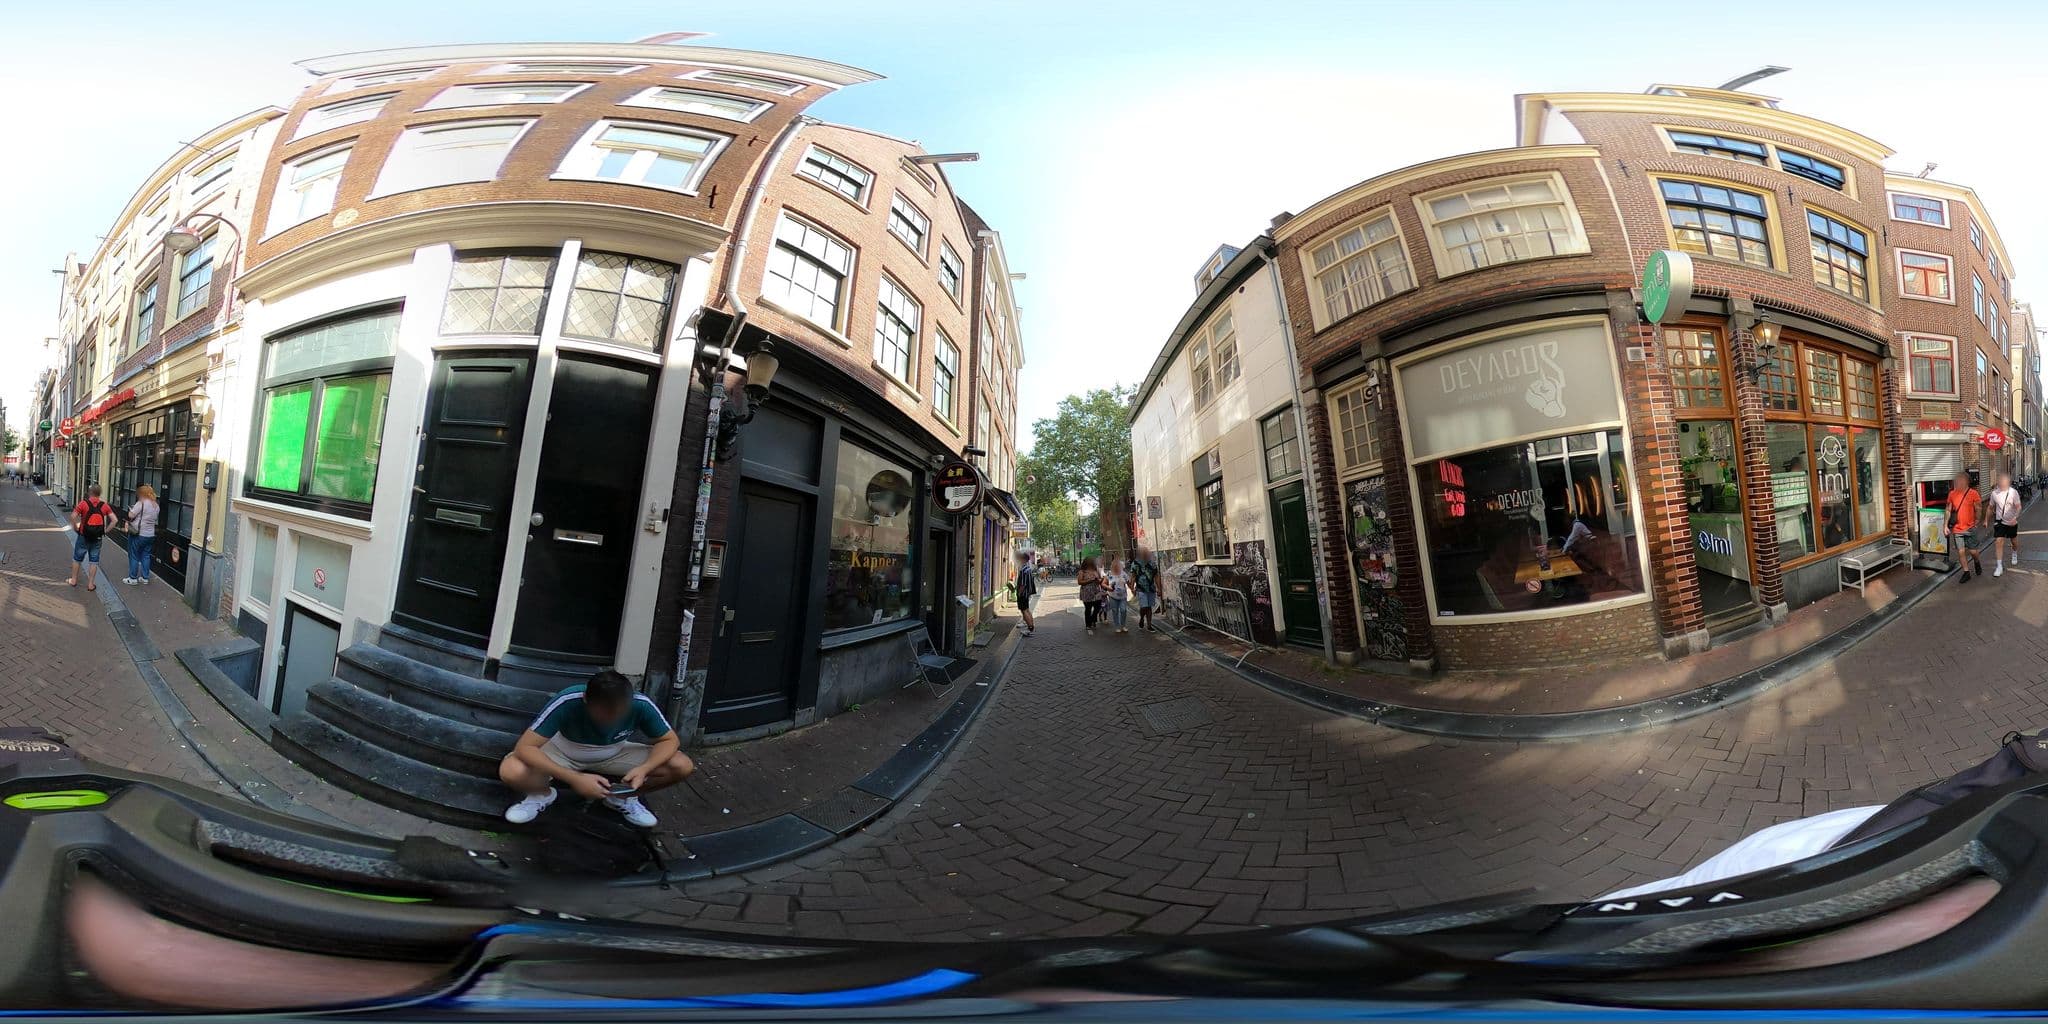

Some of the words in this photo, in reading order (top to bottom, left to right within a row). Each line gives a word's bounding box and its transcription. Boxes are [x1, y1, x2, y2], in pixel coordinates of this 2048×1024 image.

[1818, 469, 1849, 492] imi
[1497, 487, 1546, 510] DEYACOS
[1599, 891, 1744, 912] VAN
